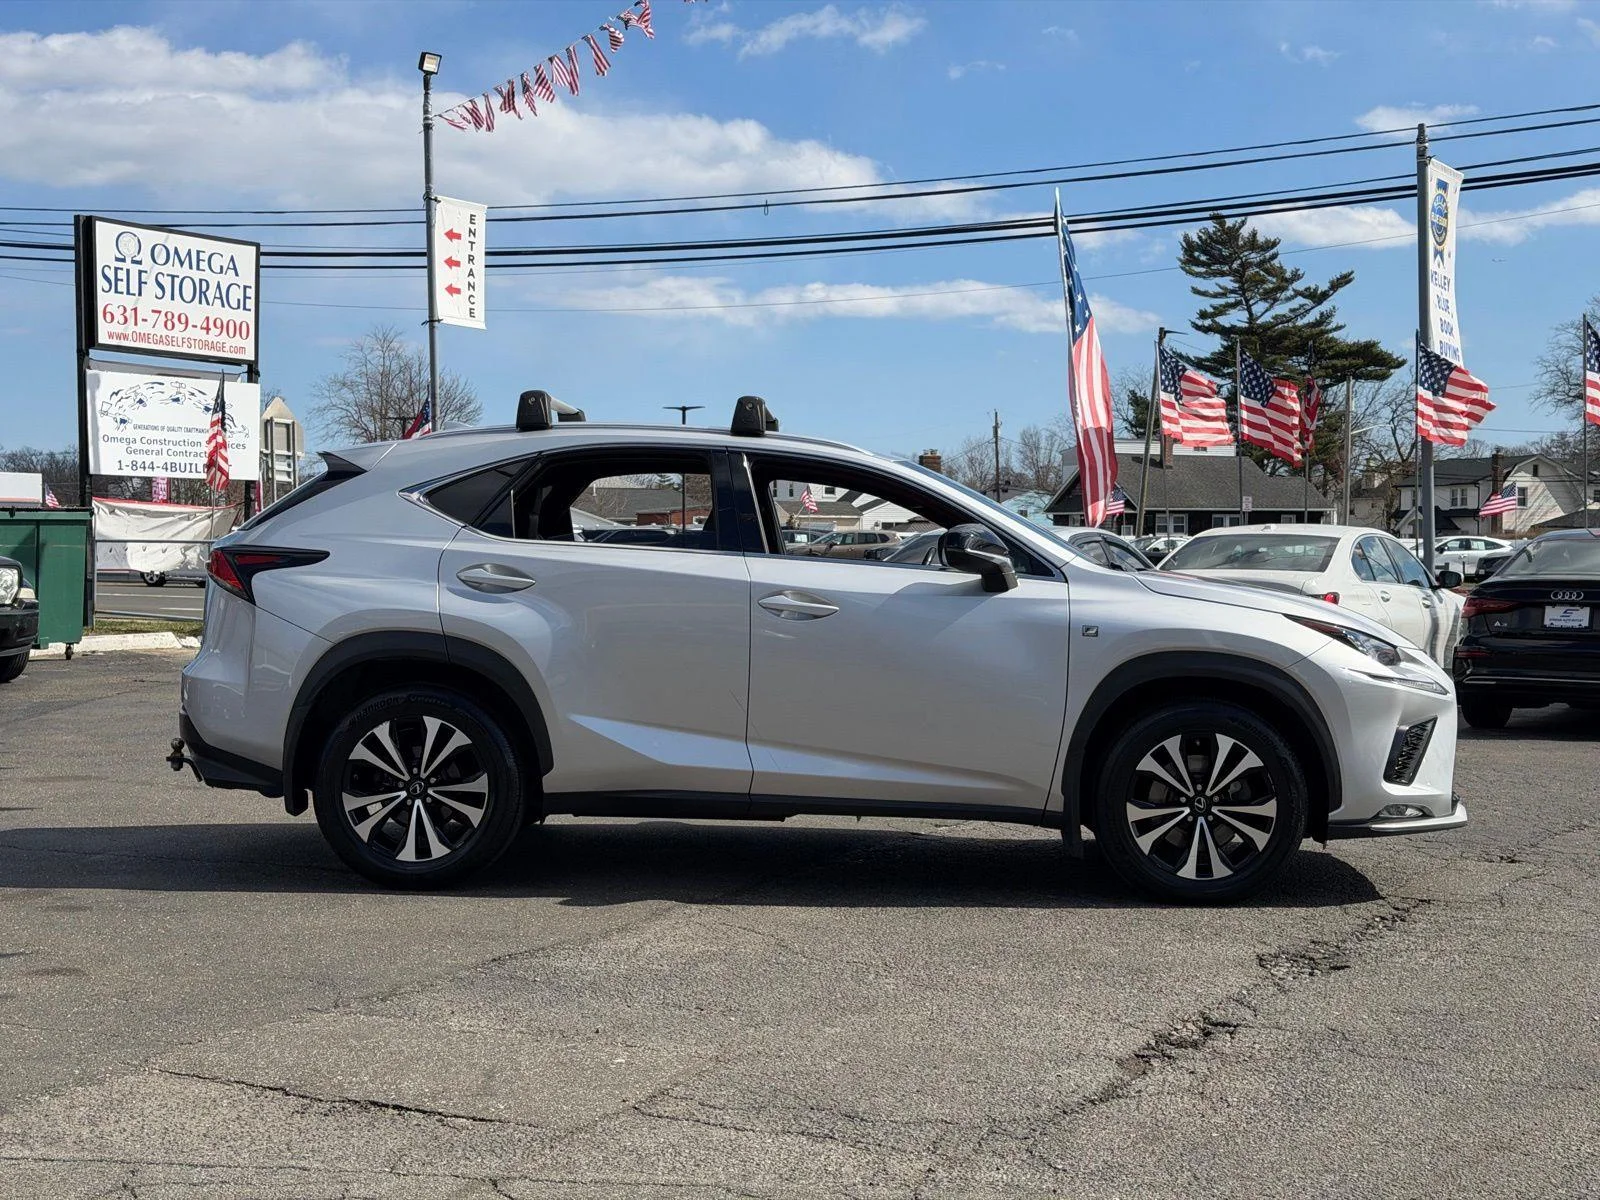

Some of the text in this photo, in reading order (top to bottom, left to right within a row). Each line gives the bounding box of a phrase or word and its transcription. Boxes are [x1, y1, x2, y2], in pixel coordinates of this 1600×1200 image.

[150, 243, 240, 277] OMEGA
[467, 213, 477, 319] ENTRANCE
[101, 264, 252, 312] SELF STORAGE
[1430, 269, 1451, 292] KELLEY
[102, 303, 250, 341] 631-789-4900
[1439, 340, 1461, 362] BUYING
[102, 434, 137, 446] Omega
[140, 436, 202, 448] Construction
[125, 446, 164, 457] General
